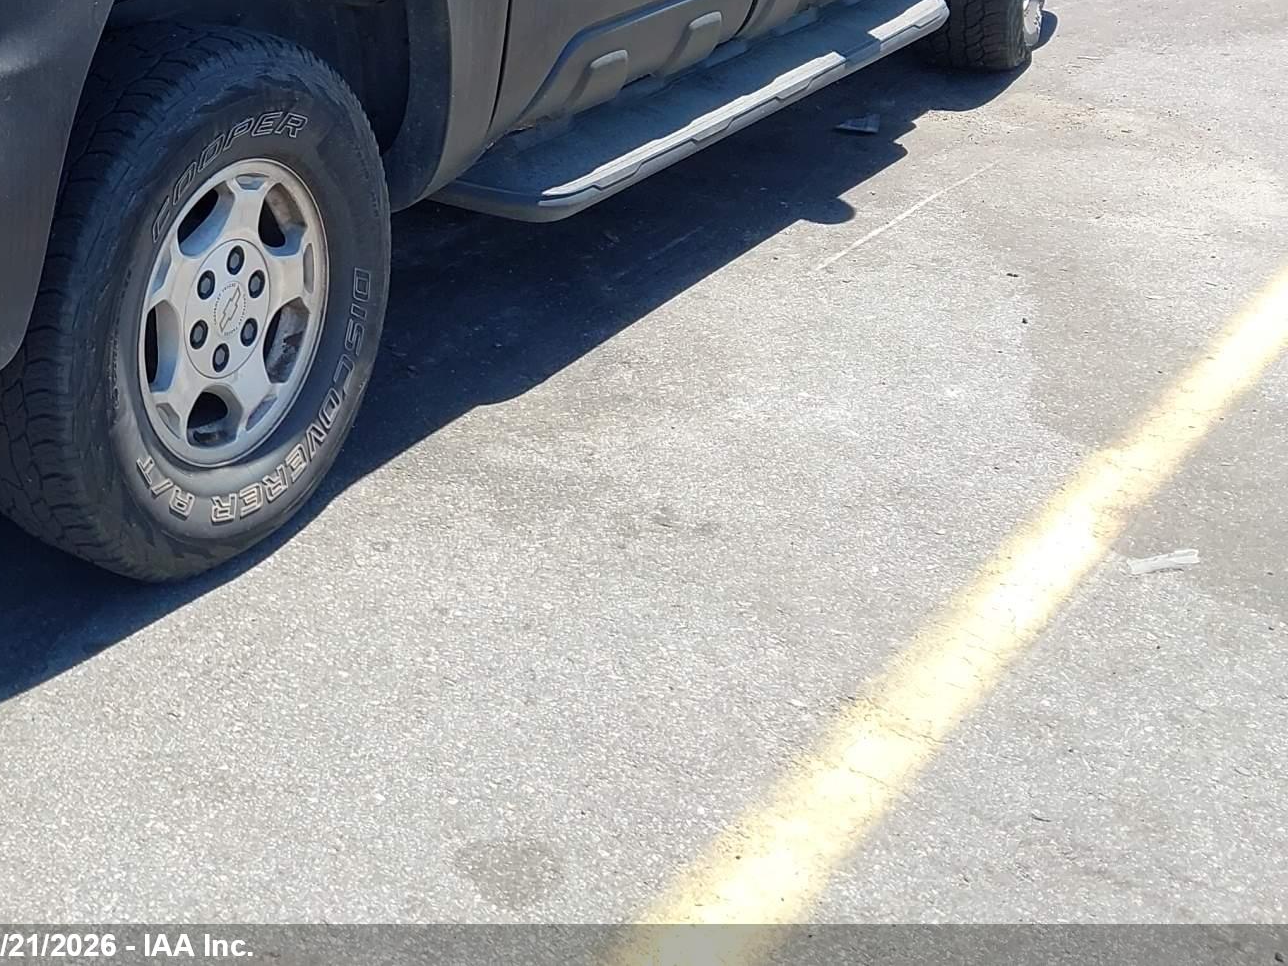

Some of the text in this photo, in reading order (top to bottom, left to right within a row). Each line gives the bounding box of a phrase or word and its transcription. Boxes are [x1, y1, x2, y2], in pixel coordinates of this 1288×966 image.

[152, 111, 308, 243] COOPER
[209, 266, 372, 524] DISCOVERER
[136, 455, 196, 520] A/T
